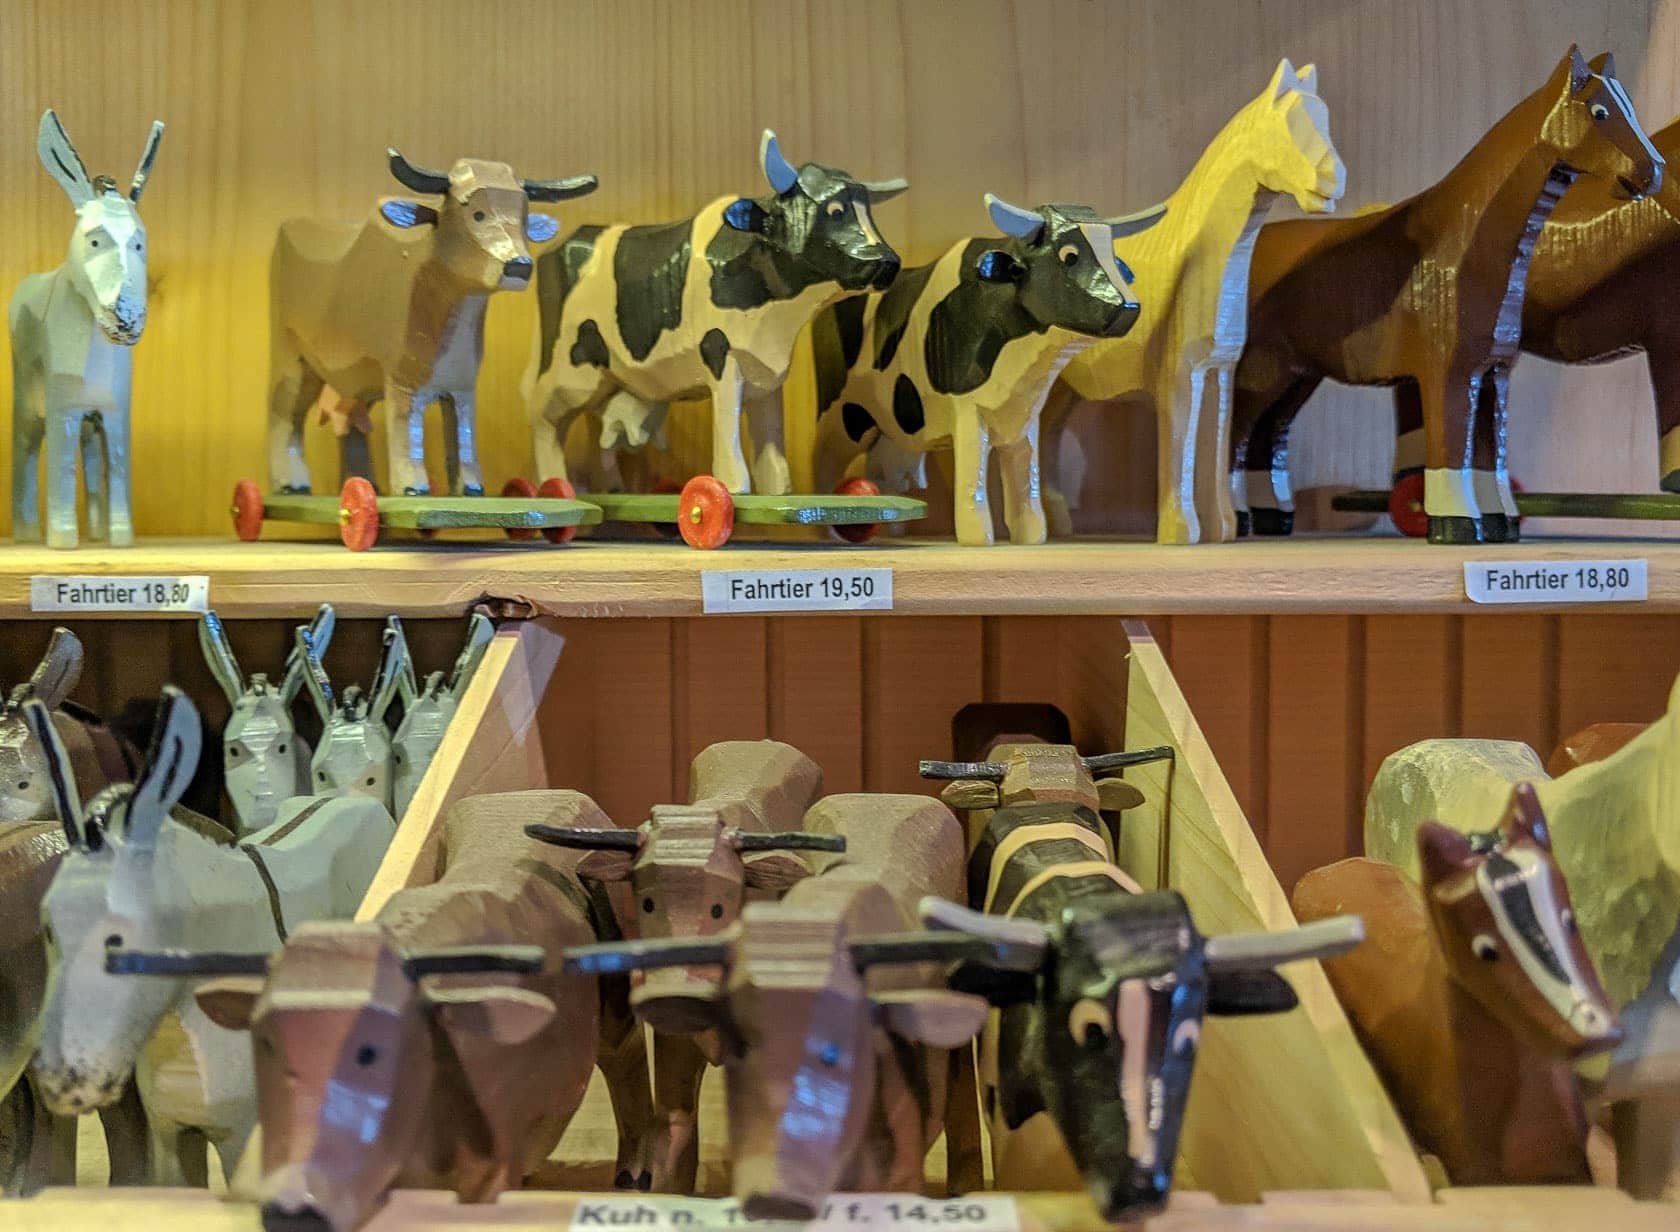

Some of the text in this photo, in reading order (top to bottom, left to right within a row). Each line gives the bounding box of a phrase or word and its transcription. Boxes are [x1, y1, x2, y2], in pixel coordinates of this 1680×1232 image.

[731, 576, 874, 601] Fahrtier 19,50
[1486, 567, 1629, 592] Fahrtier 18,80
[57, 583, 190, 607] Fahrtier 18,80
[579, 1204, 657, 1225] Kuh
[670, 1209, 704, 1226] n.
